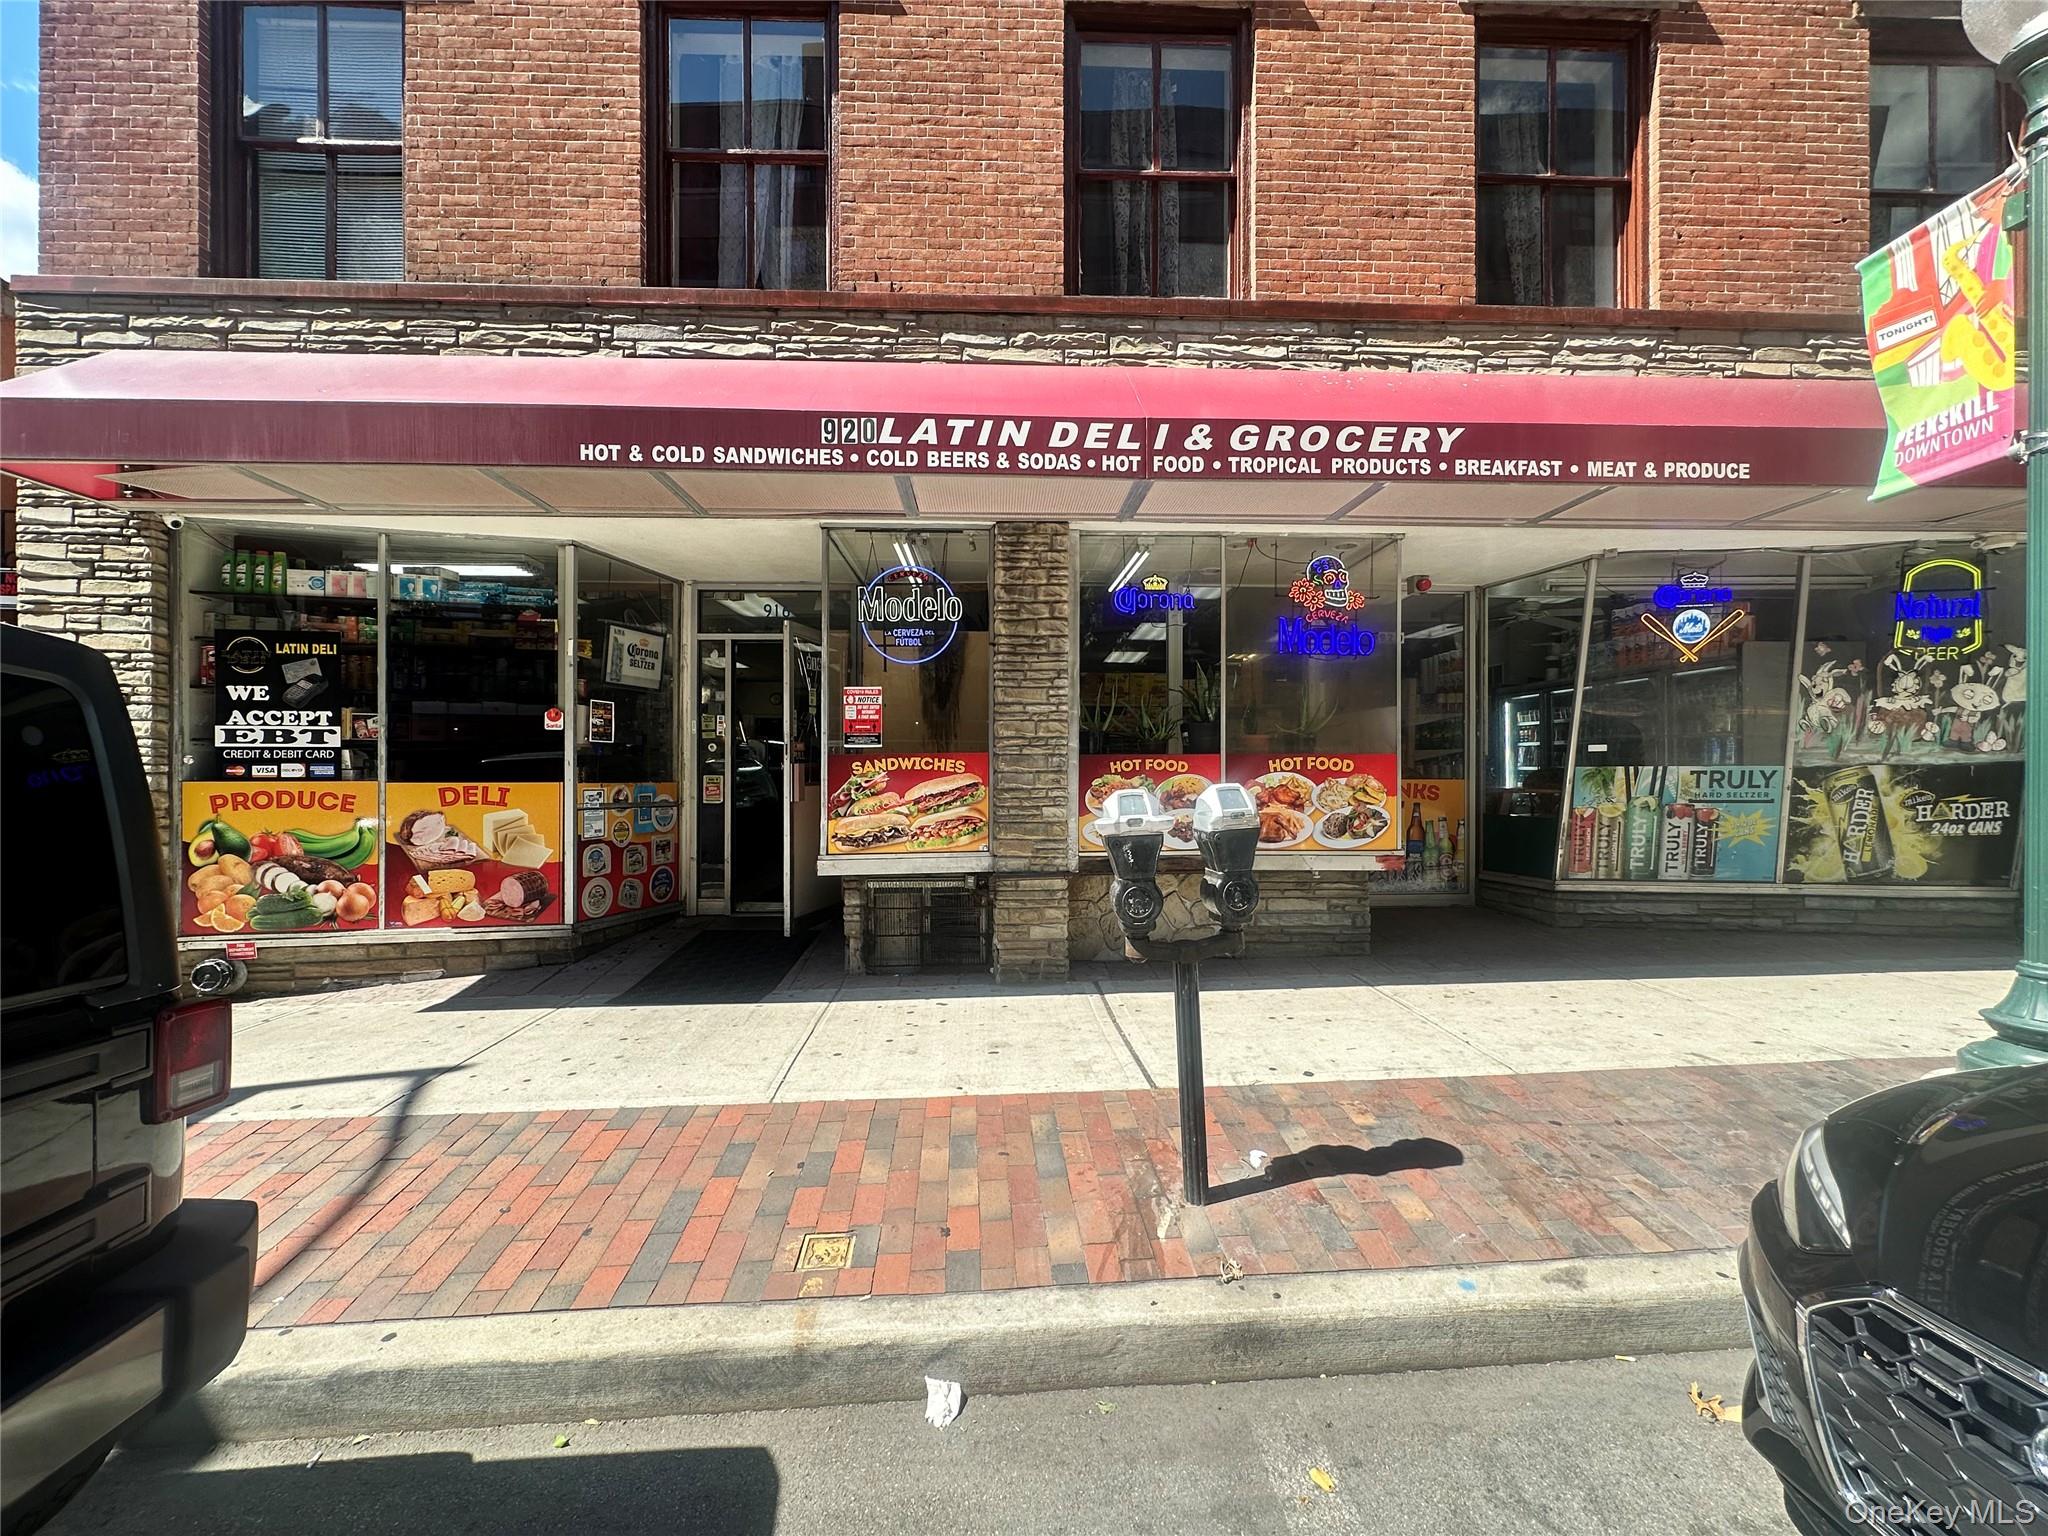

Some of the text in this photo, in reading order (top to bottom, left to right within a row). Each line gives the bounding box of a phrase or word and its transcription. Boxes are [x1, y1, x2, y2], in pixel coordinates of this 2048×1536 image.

[1879, 315, 1934, 341] TONIGHT!
[1894, 391, 1999, 448] PEEKSKILL
[821, 417, 1466, 453] 920 LATIN DELI & GROCERY
[1894, 415, 1994, 467] DOWNTOWN
[579, 443, 1751, 480] HOT & COLD SANDWICHES COLD BEERS & SODAS HOT FOOD TROPICAL PRODUCTS BREAKFAST MEAT & PRODUCE
[888, 571, 930, 582] CERVEZA
[763, 604, 790, 618] 916
[857, 586, 963, 622] Modelo
[1114, 586, 1196, 615] Corona
[1895, 591, 1982, 621] Natural
[1305, 610, 1349, 624] CERVEZA
[893, 628, 924, 637] CERVEZA
[896, 636, 922, 646] FÚTBOL
[1277, 616, 1376, 657] Modelo
[275, 643, 338, 655] LATIN DELI
[627, 642, 659, 660] Corona
[629, 658, 656, 671] SELTZER
[225, 685, 270, 701] WE
[857, 696, 880, 704] NOTICE
[225, 710, 333, 726] ACCEPT
[220, 729, 337, 744] EBT
[223, 749, 335, 759] CREDIT & DEBIT CARD
[1268, 756, 1355, 773] HOT FOOD
[851, 757, 966, 775] SANDWICHES
[1109, 759, 1189, 774] HOT FOOD
[1690, 769, 1778, 790] TRULY
[209, 790, 357, 814] PRODUCE
[438, 785, 511, 808] DELI
[1916, 801, 2010, 822] HARDER
[1843, 788, 1875, 865] HARDER
[1931, 821, 2003, 835] 24oz CANS
[1597, 821, 1612, 872] TRULY
[1630, 815, 1648, 870] TRULY
[1664, 821, 1682, 873] TRULY
[1694, 823, 1709, 867] TRULY
